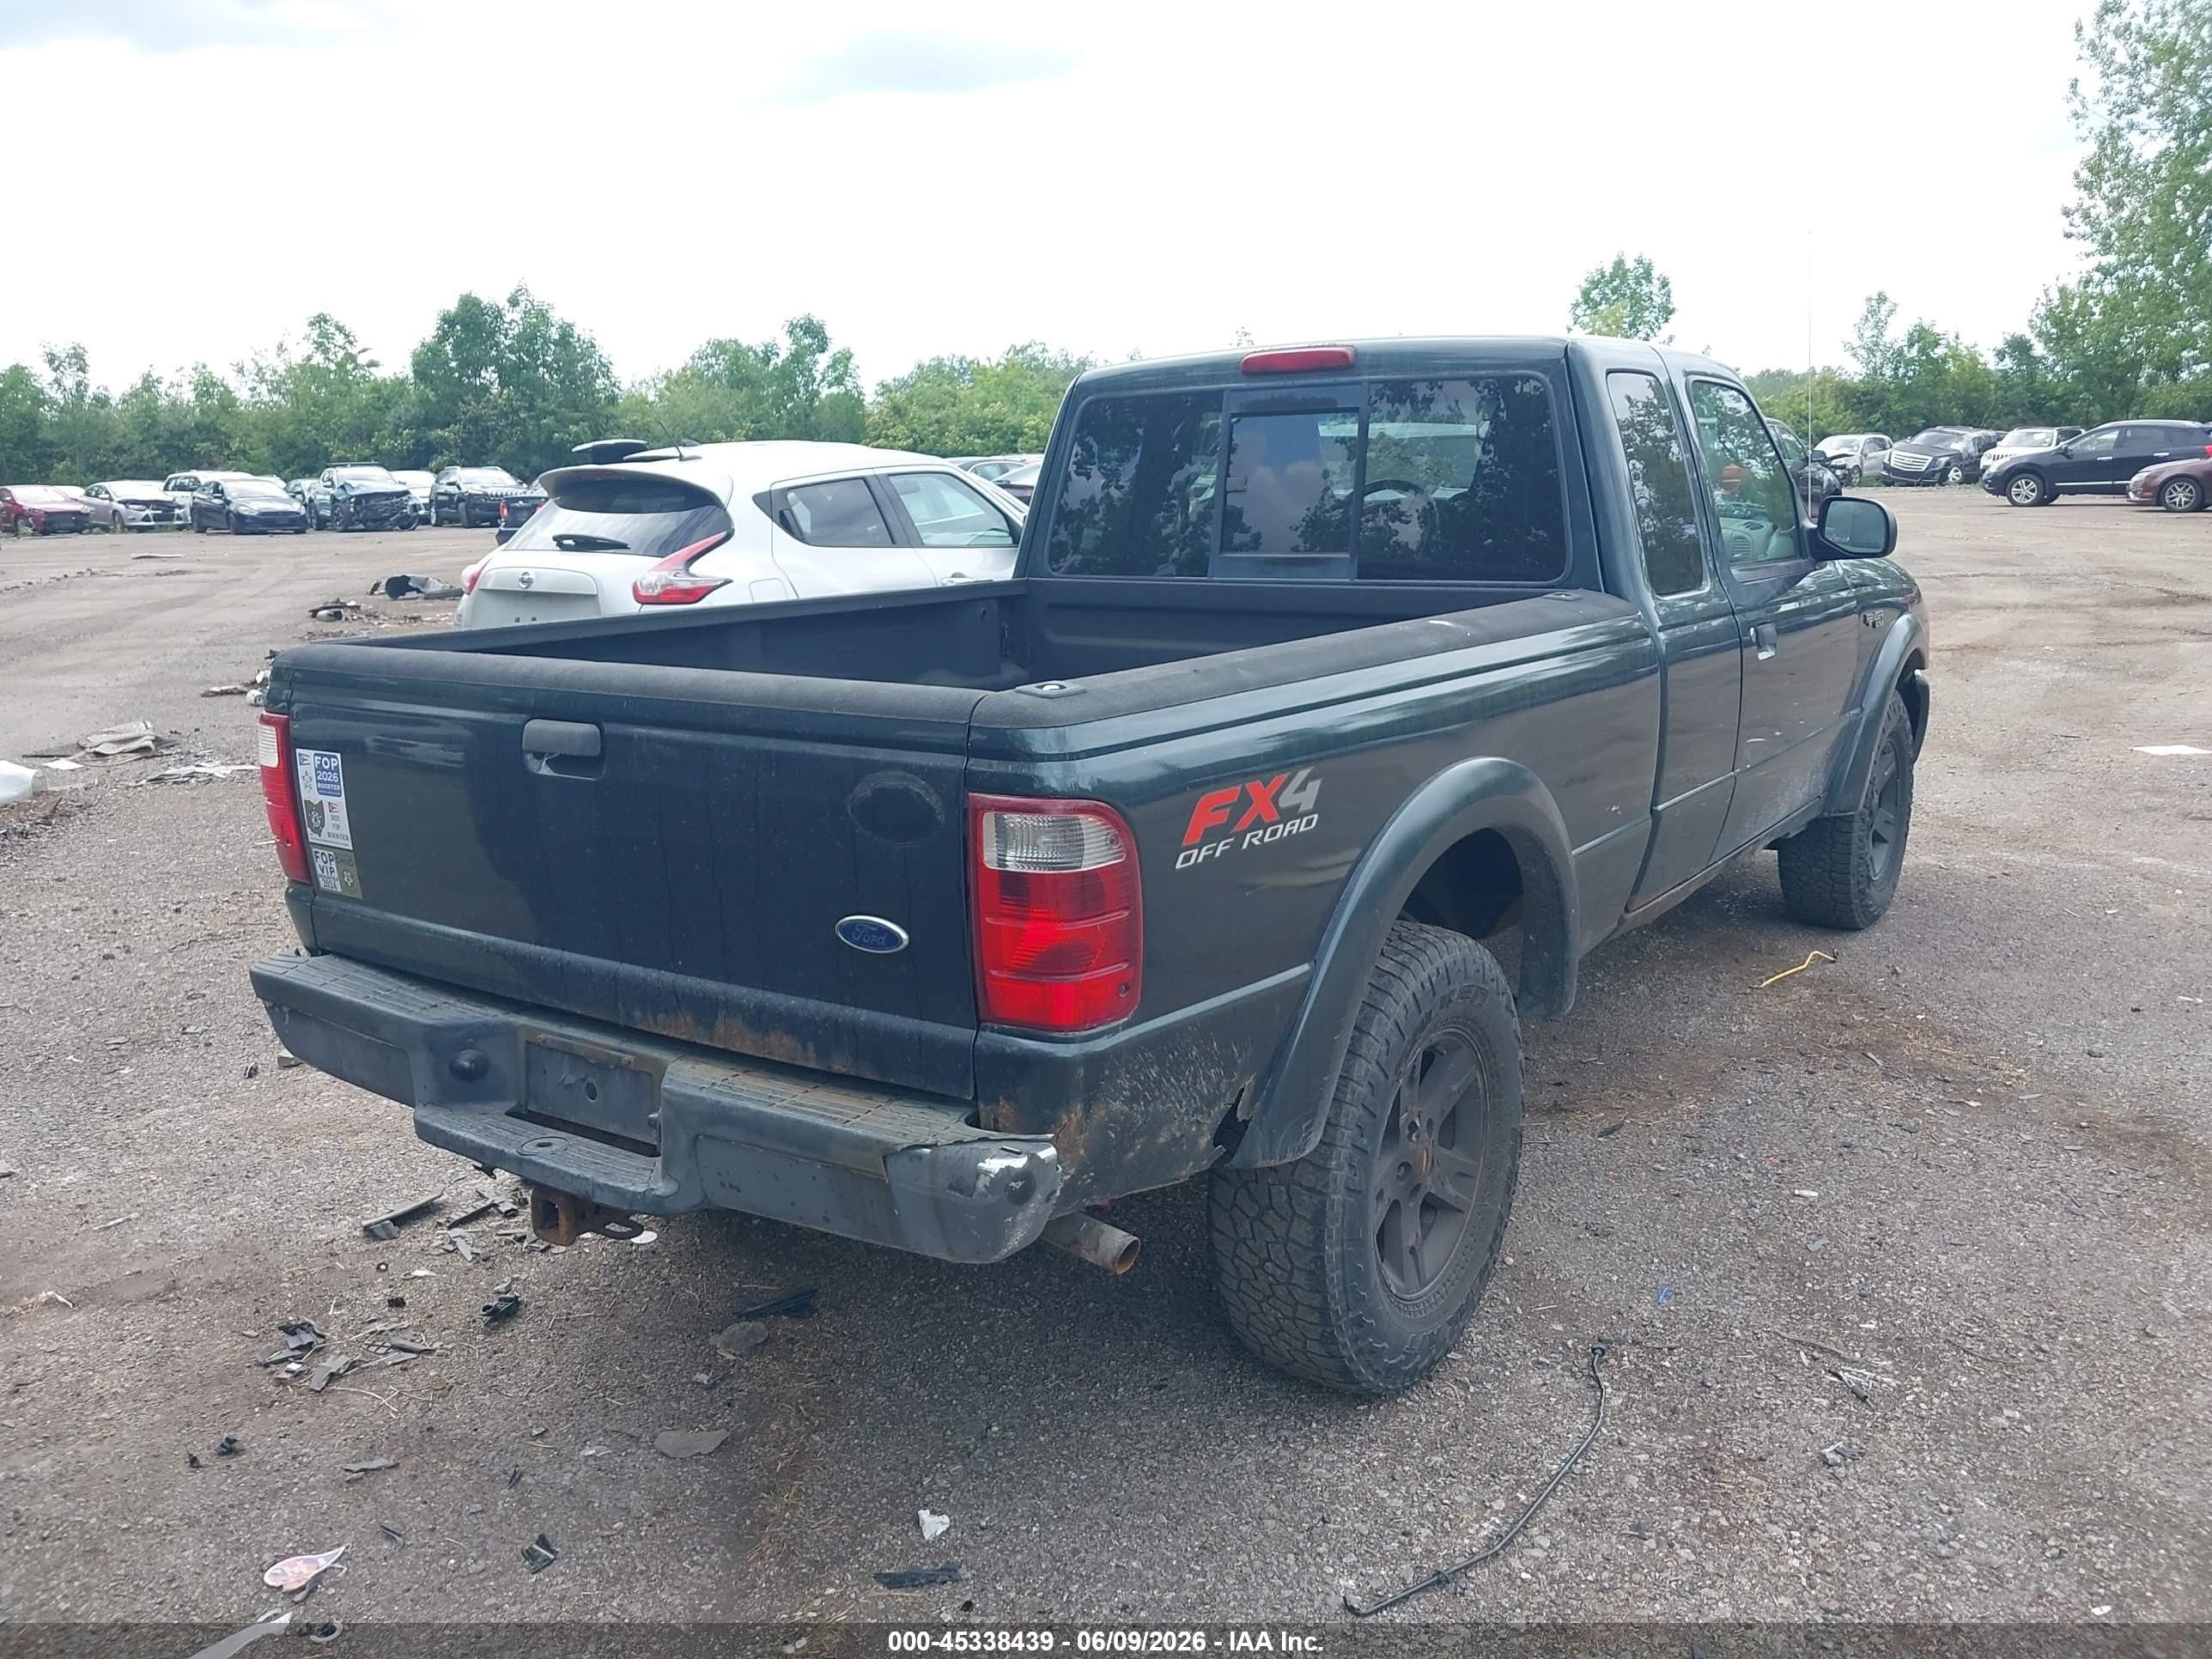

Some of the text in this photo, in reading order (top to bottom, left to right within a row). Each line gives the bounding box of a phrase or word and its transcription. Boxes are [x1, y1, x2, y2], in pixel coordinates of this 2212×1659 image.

[314, 755, 338, 770] FOP
[316, 771, 338, 782] 2026
[317, 782, 340, 791] BOOSTER
[1182, 765, 1323, 848] FX4
[1175, 813, 1319, 870] OFF ROAD
[313, 851, 334, 866] FOP
[319, 864, 335, 876] VIP
[852, 923, 888, 945] Ford
